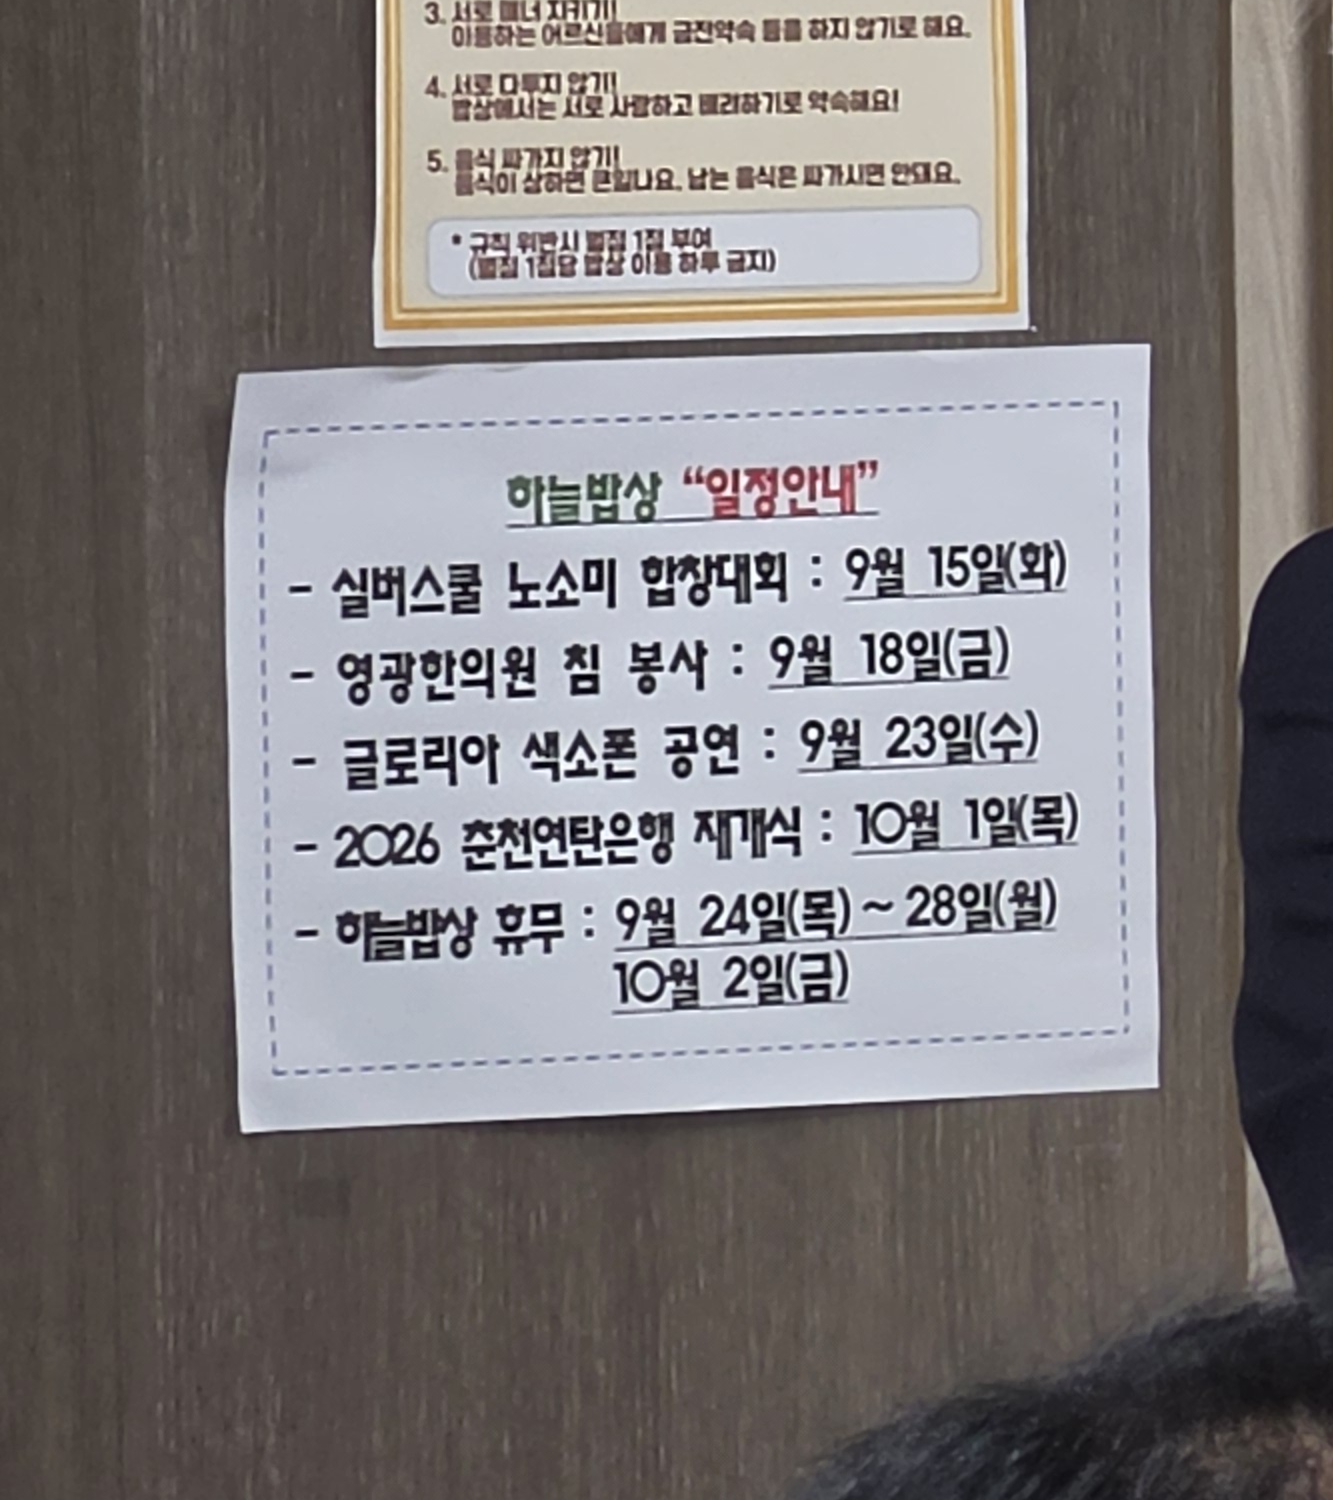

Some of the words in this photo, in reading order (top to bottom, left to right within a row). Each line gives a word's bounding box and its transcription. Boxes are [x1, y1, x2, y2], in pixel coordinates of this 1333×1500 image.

[424, 2, 446, 24] 3.
[425, 76, 446, 98] 4.
[427, 150, 448, 173] 5.
[507, 471, 663, 523] 하늘밥상
[333, 563, 483, 620] 실버스쿨
[508, 558, 618, 611] 노소미
[641, 551, 788, 606] 합창대회
[844, 546, 905, 597] 9월
[927, 540, 1068, 593] 15일(화)
[338, 648, 536, 705] 영광한의원
[563, 643, 600, 697] 침
[629, 639, 708, 693] 봉사
[769, 633, 832, 684] 9월
[860, 626, 1010, 683] 18일(금)
[342, 734, 500, 791] 글로리아
[523, 728, 637, 782] 색소폰
[664, 725, 740, 777] 공연
[800, 717, 862, 770] 9월
[885, 711, 1039, 767] 23일(수)
[334, 821, 441, 870] 2026
[462, 810, 675, 872] 춘천연탄은행
[694, 806, 803, 861] 재개식
[853, 801, 940, 852] 10월
[965, 792, 1079, 848] 1일(목)
[336, 908, 477, 962] 하늘밥상
[494, 903, 564, 957] 휴무
[615, 897, 676, 948] 9월
[699, 888, 850, 942] 24일(목)
[906, 879, 1058, 936] 28일(월)
[613, 960, 700, 1010] 10월
[723, 954, 849, 1007] 2일(금)
